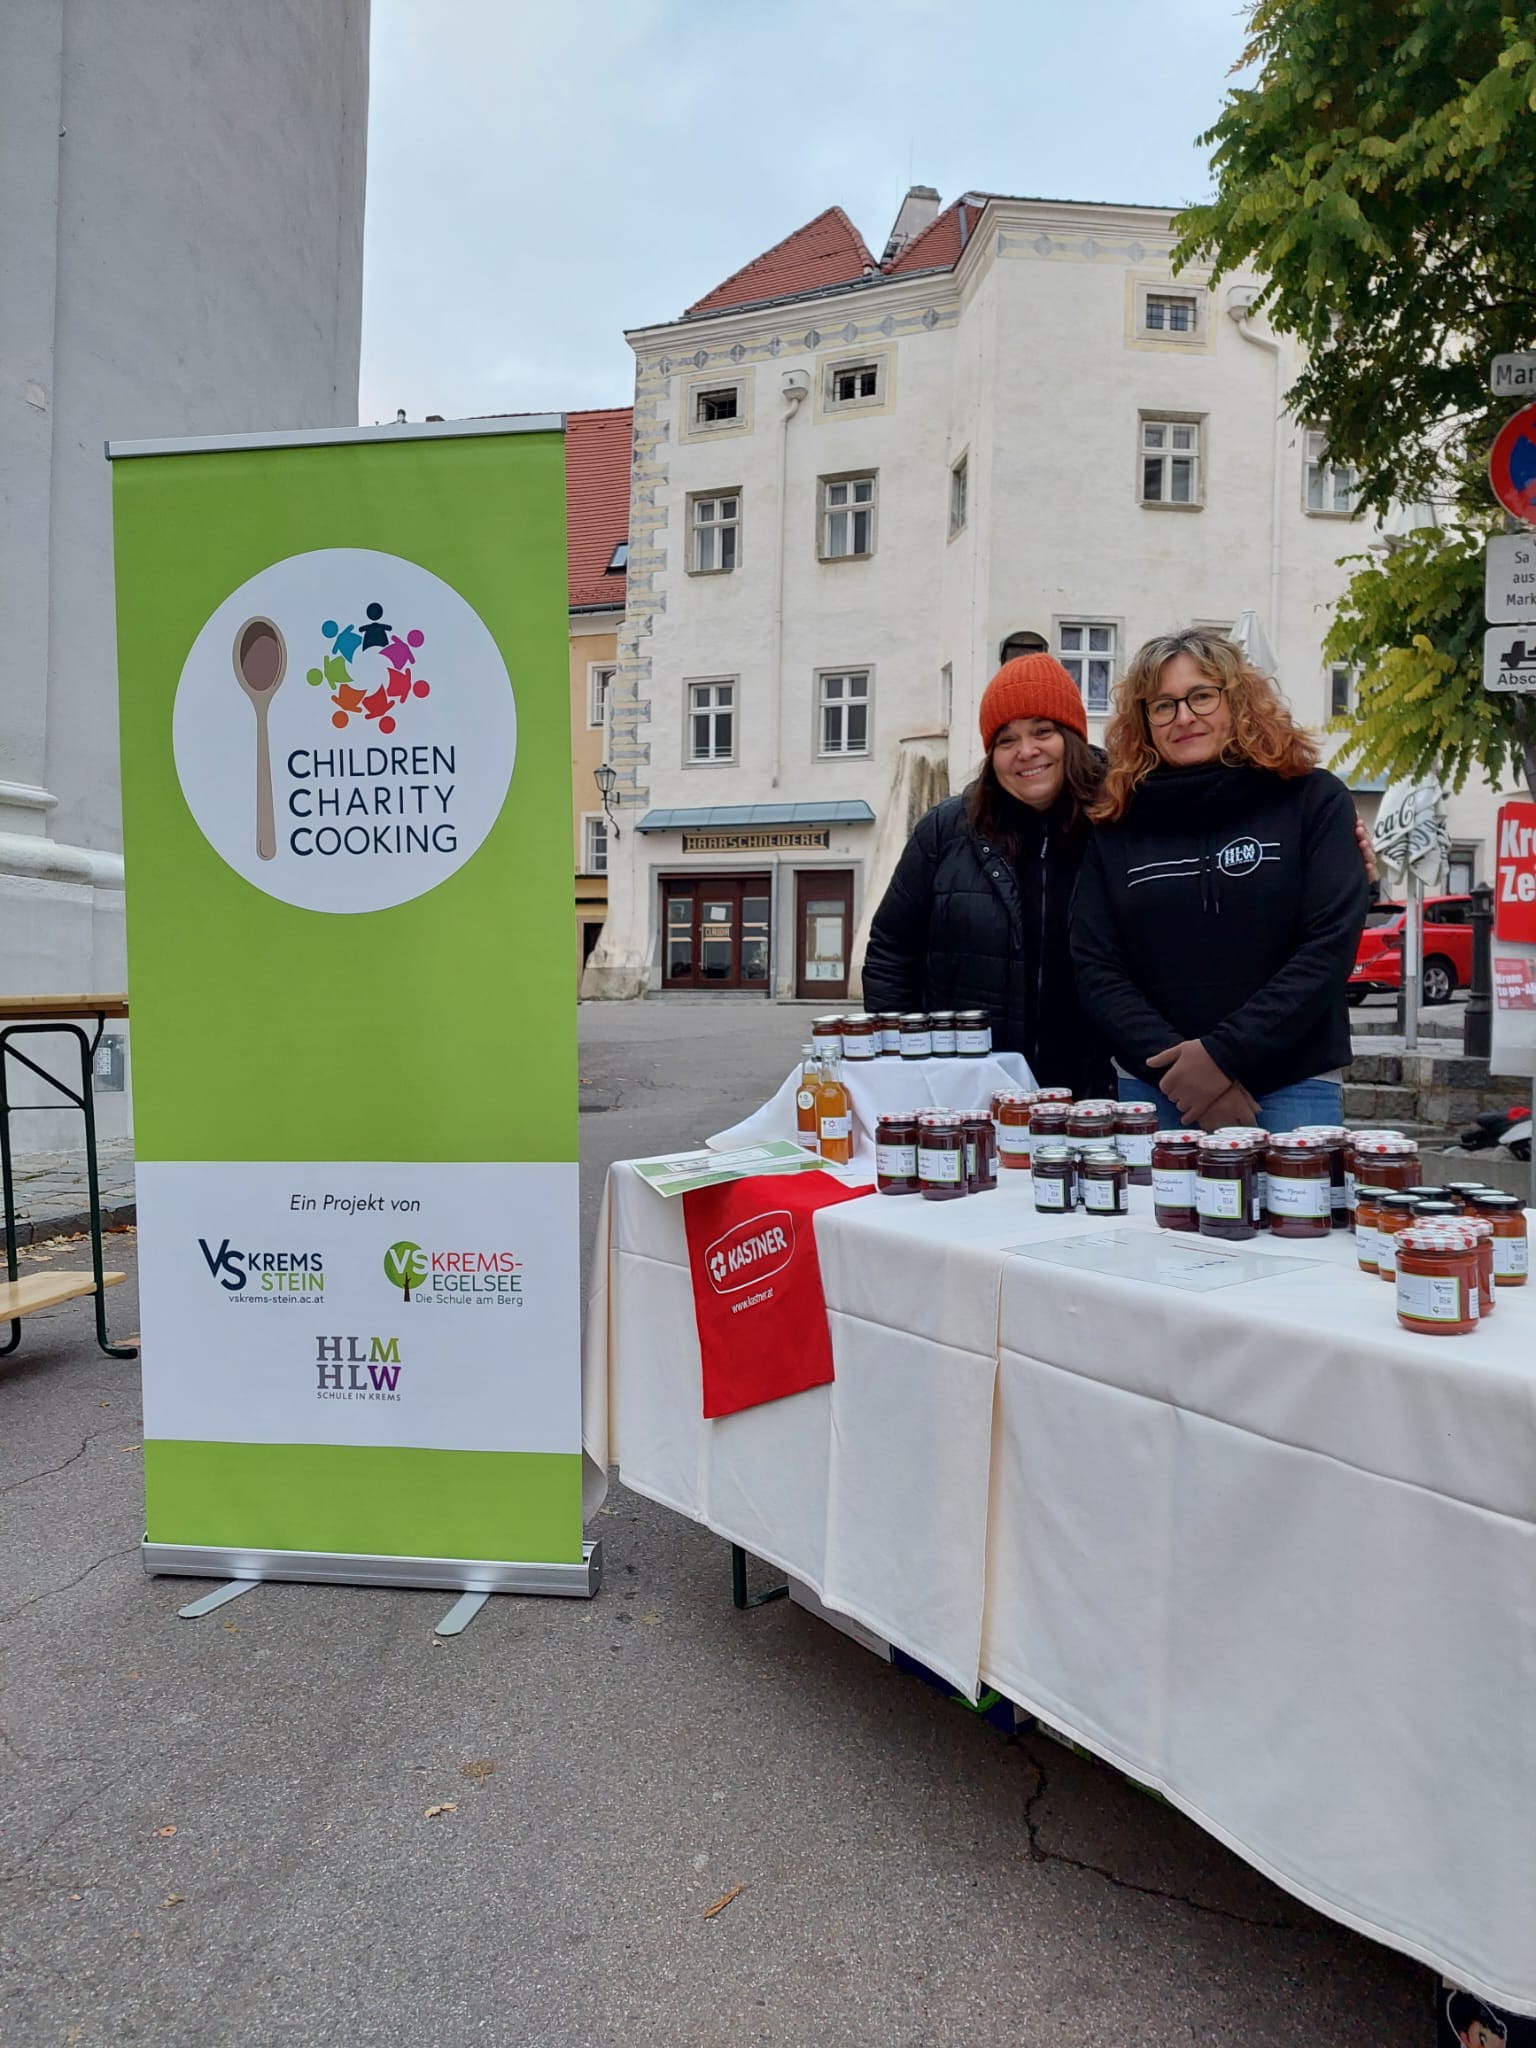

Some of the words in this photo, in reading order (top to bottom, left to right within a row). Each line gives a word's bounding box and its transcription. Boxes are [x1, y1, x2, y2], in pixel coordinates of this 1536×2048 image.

[1514, 551, 1530, 564] Sa
[287, 746, 456, 779] CHILDREN
[288, 785, 455, 818] CHARITY
[290, 824, 457, 857] COOKING
[686, 834, 825, 849] HAARSCHNEIDEREI
[1500, 820, 1536, 858] Kr
[1500, 864, 1536, 903] Ze
[290, 1194, 316, 1211] Ein
[323, 1194, 384, 1216] Projekt
[391, 1200, 420, 1212] von
[389, 1249, 429, 1275] VS
[431, 1252, 523, 1273] KREMS-
[728, 1227, 787, 1272] KASTNER
[198, 1239, 247, 1291] VS
[249, 1253, 323, 1271] KREMS
[261, 1273, 324, 1291] STEIN
[433, 1275, 522, 1292] EGELSEE
[228, 1293, 324, 1304] vskrems-stein.ac.at
[415, 1293, 432, 1303] Die
[436, 1294, 472, 1305] Schule
[476, 1296, 493, 1305] am
[497, 1295, 523, 1307] Berg
[731, 1287, 774, 1313] www.kastner.at
[316, 1336, 401, 1363] HLM
[316, 1364, 401, 1391] HLW
[317, 1391, 353, 1400] SCHULE
[356, 1392, 366, 1400] IN
[369, 1393, 401, 1401] KREMS
